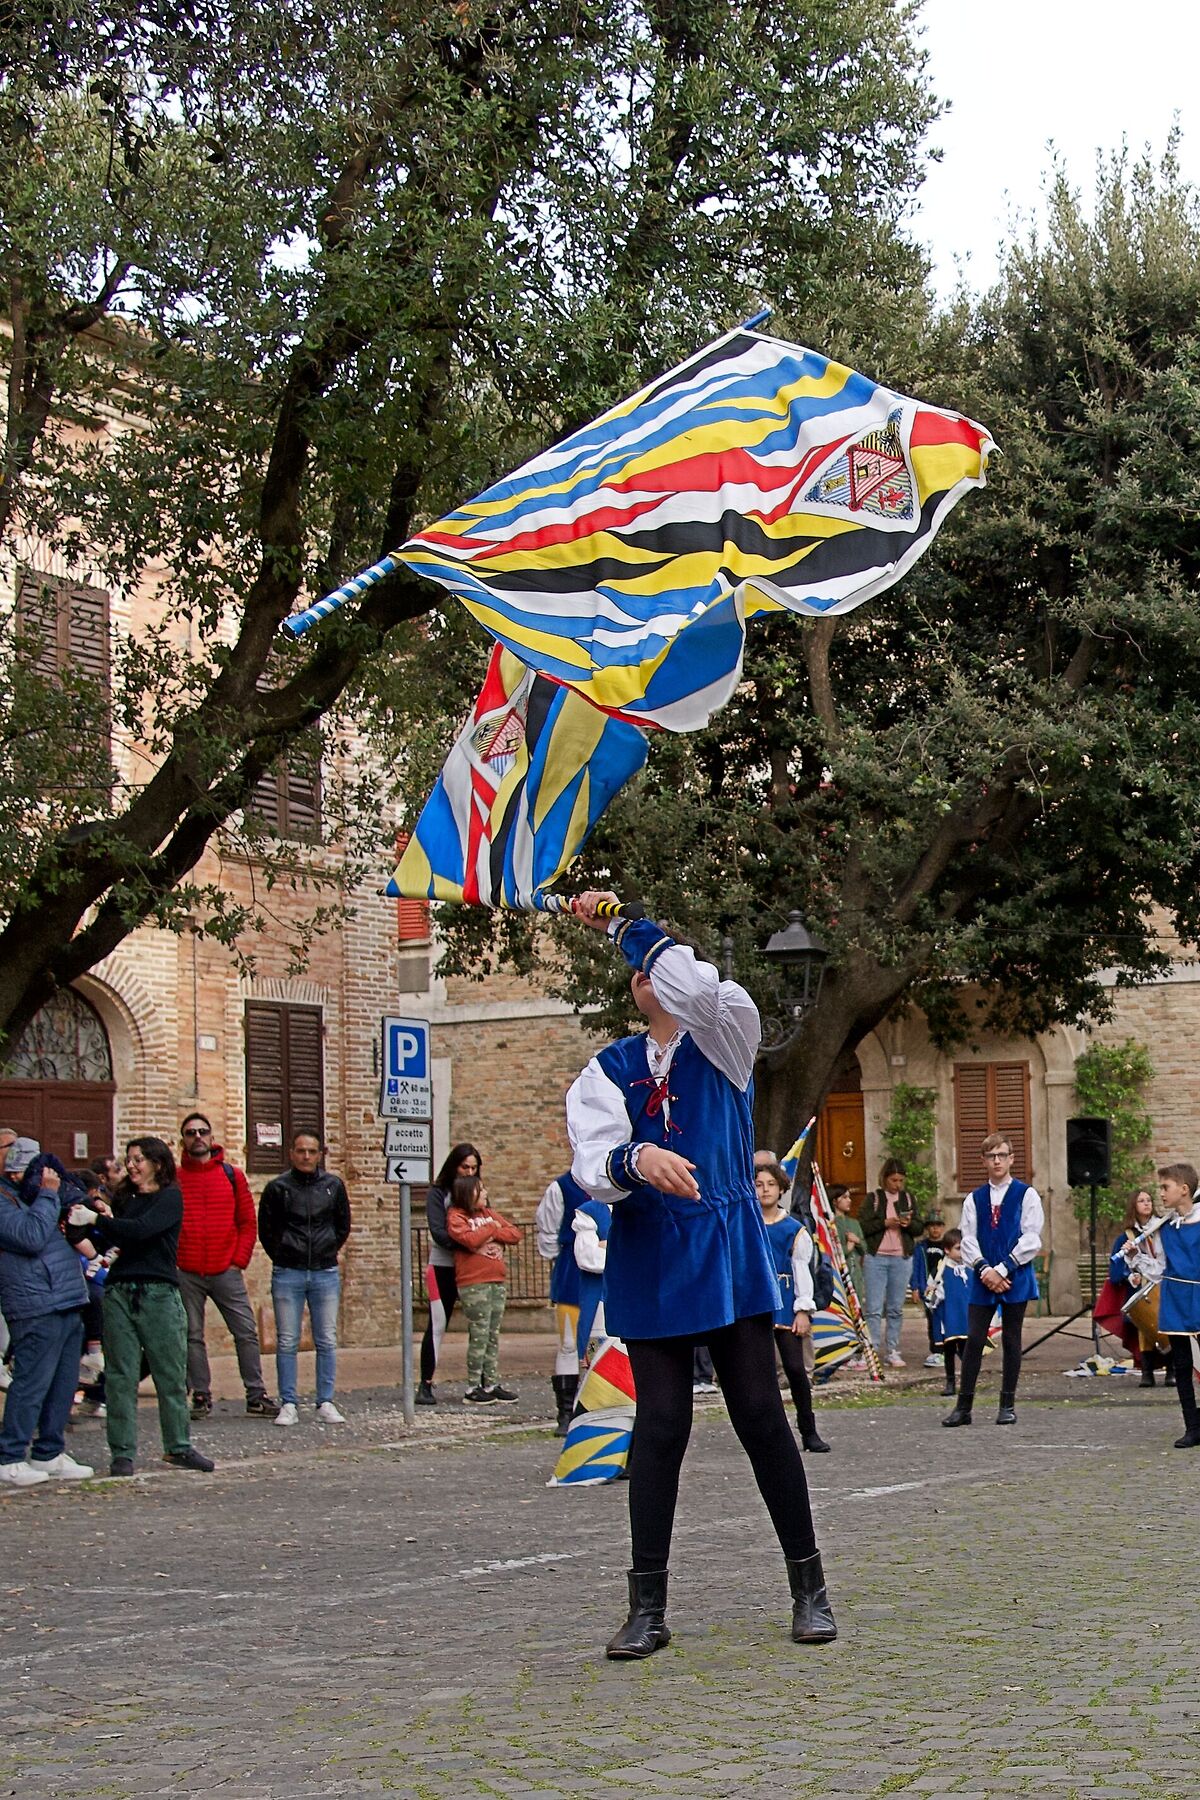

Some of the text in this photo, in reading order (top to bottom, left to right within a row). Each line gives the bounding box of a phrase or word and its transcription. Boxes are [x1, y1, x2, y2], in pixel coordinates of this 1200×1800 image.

[397, 1031, 419, 1071] P
[395, 1129, 424, 1137] eccetto
[389, 1143, 429, 1152] autorizzati
